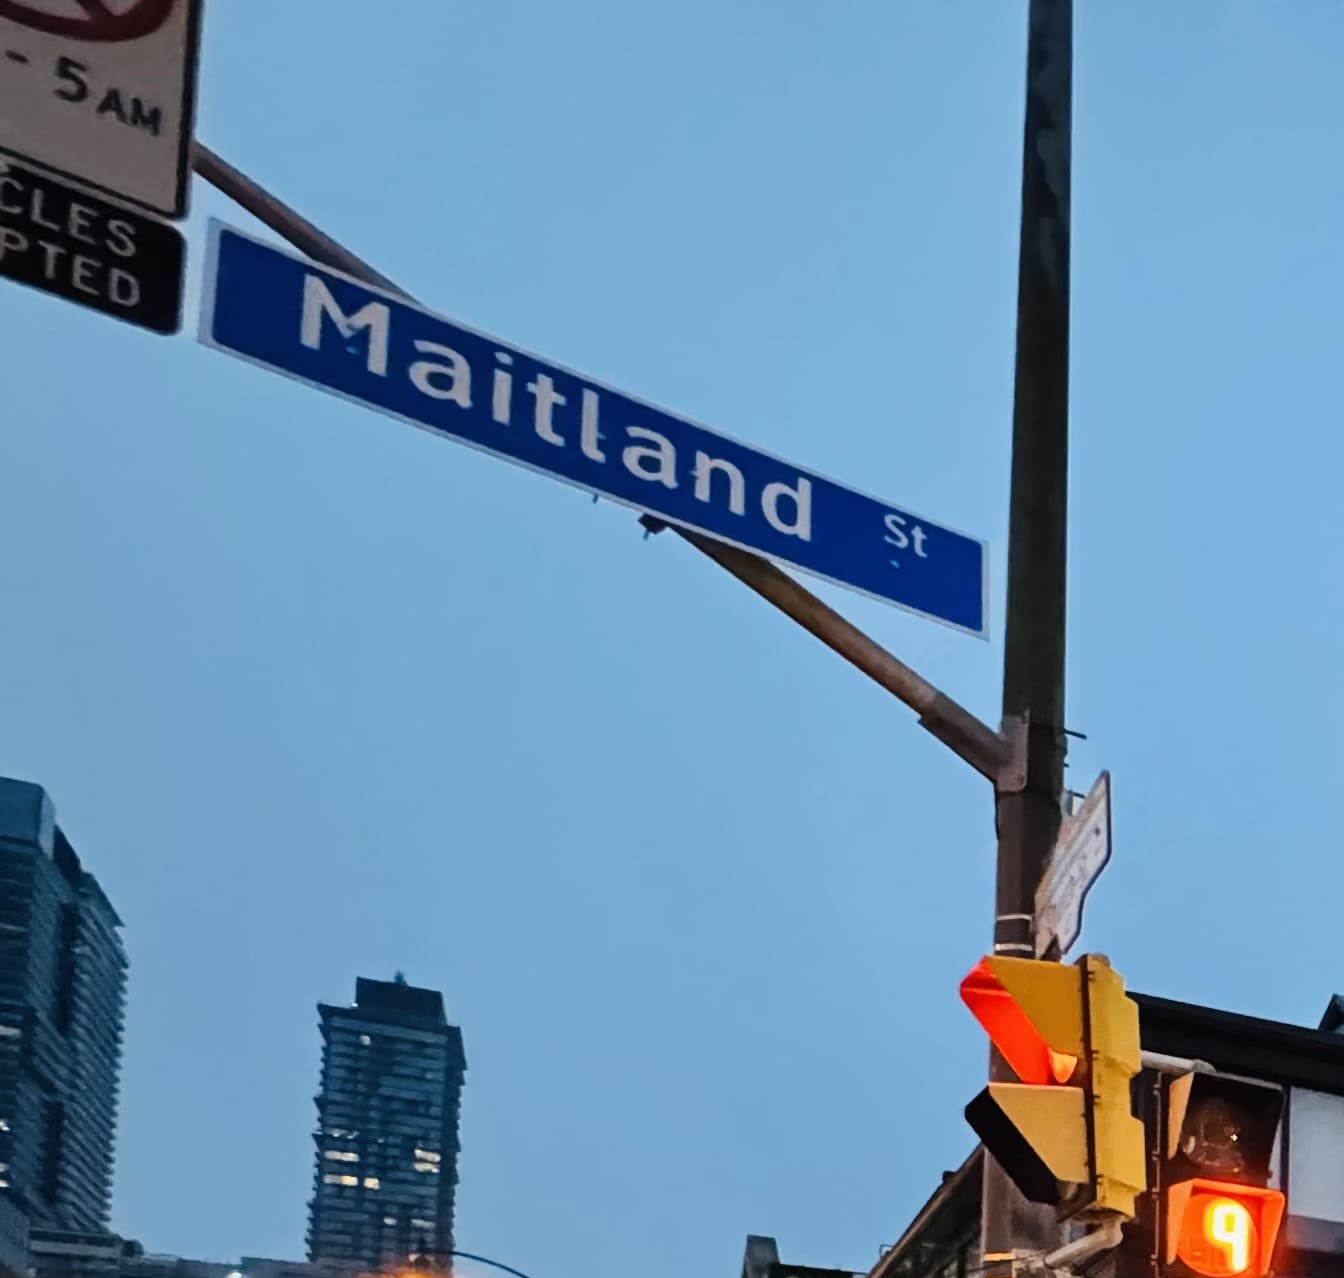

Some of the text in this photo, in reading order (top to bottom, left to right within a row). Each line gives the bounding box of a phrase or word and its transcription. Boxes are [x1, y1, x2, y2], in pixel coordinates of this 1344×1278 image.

[297, 273, 929, 560] Maitland St
[1211, 1202, 1249, 1273] 9
